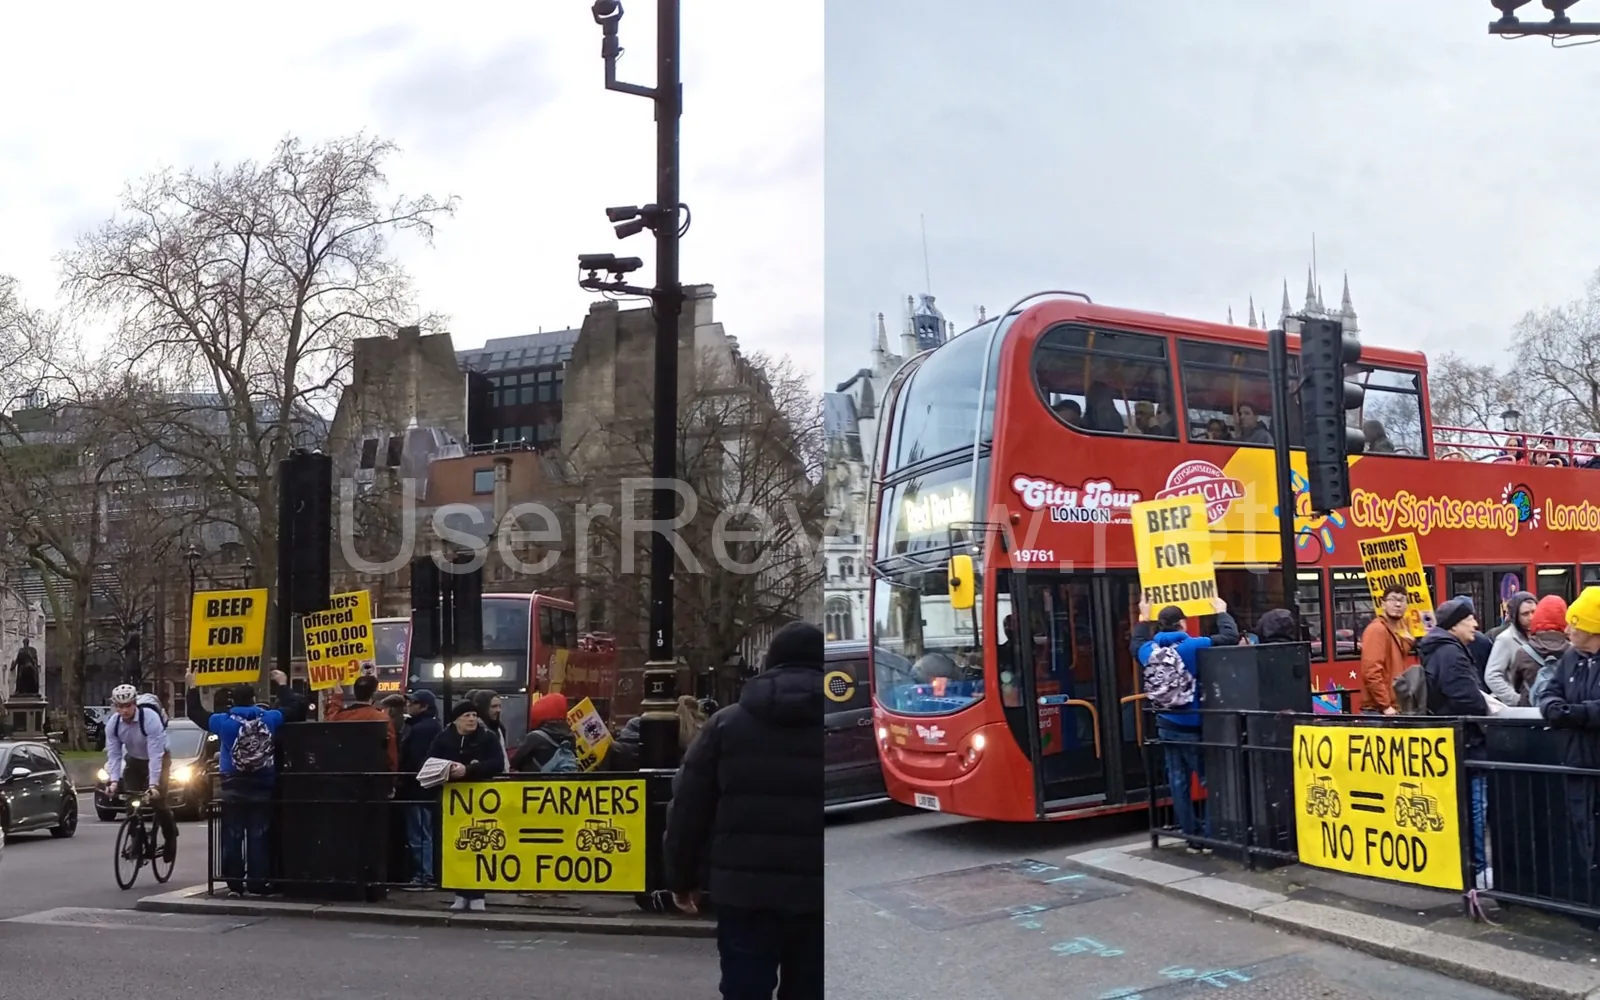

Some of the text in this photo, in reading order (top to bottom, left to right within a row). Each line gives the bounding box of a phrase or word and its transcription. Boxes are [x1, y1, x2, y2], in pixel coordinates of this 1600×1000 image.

[1013, 477, 1140, 509] City Tour
[1051, 507, 1110, 523] LONDON
[1147, 506, 1191, 533] BEEP
[1208, 504, 1226, 520] UR
[1014, 549, 1054, 562] 19761
[1155, 543, 1191, 568] FOR
[1360, 538, 1408, 557] Farmers
[1365, 553, 1406, 572] offered
[1144, 580, 1214, 604] FREEDOM
[1370, 571, 1422, 592] £100000
[207, 597, 253, 618] BEEP
[304, 609, 353, 629] offered
[208, 626, 244, 646] FOR
[306, 625, 368, 646] £100,000
[307, 642, 367, 662] to retire.
[191, 656, 260, 674] FREEDOM
[1299, 734, 1449, 778] NO FARMERS
[450, 786, 640, 816] NO FARMERS
[1321, 821, 1428, 873] NO FOOD
[476, 854, 613, 883] NO FOOD
